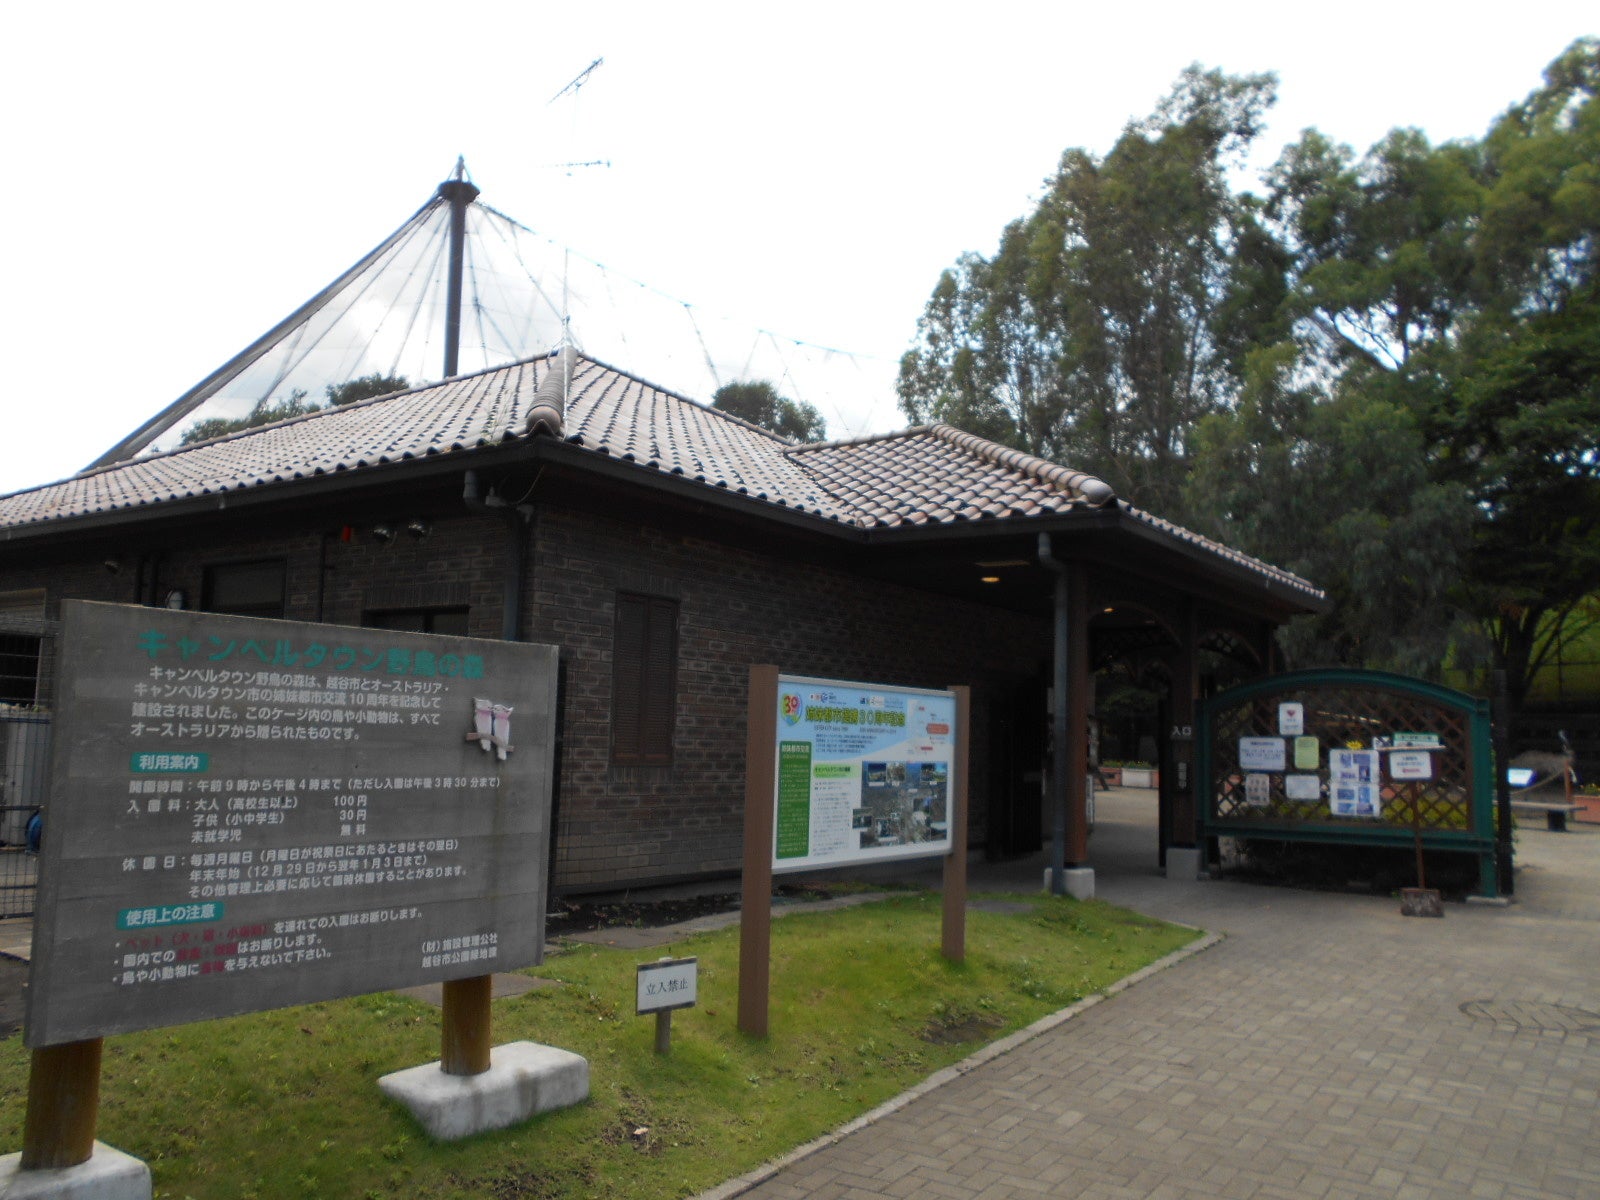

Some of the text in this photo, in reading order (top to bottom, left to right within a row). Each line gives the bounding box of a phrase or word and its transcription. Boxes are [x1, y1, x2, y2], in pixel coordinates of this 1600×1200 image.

[136, 628, 485, 680] キャンベルタウン野鳥の森
[1171, 725, 1192, 737] 入口
[138, 754, 200, 770] 利用案内
[125, 903, 216, 927] 使用上の注意
